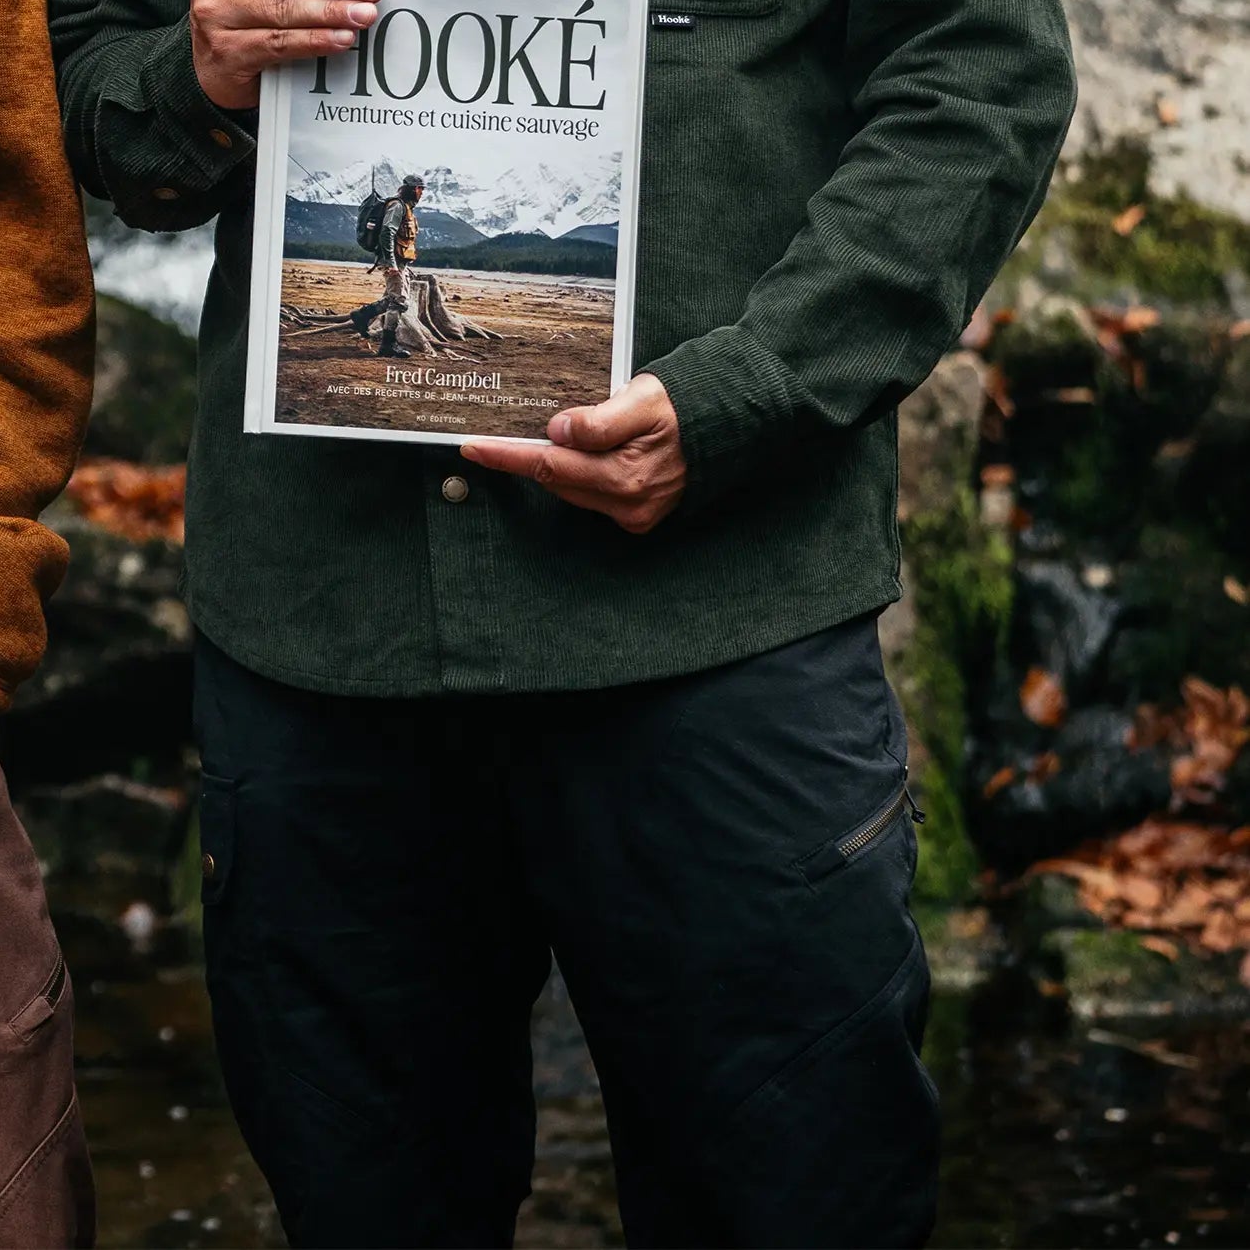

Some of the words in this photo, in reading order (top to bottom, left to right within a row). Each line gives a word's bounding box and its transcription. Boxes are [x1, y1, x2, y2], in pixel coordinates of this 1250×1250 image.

[315, 100, 414, 127] Aventures
[418, 109, 436, 128] et
[440, 110, 512, 132] cuisine
[516, 116, 600, 141] sauvage
[385, 365, 422, 385] Fred
[425, 368, 501, 390] Campbell
[326, 385, 350, 395] AVEC
[353, 387, 371, 396] DES
[375, 388, 421, 399] RECETTES
[425, 391, 436, 400] DE
[440, 392, 514, 406] JEAN-PHILIPPE
[518, 398, 559, 408] LECLERC
